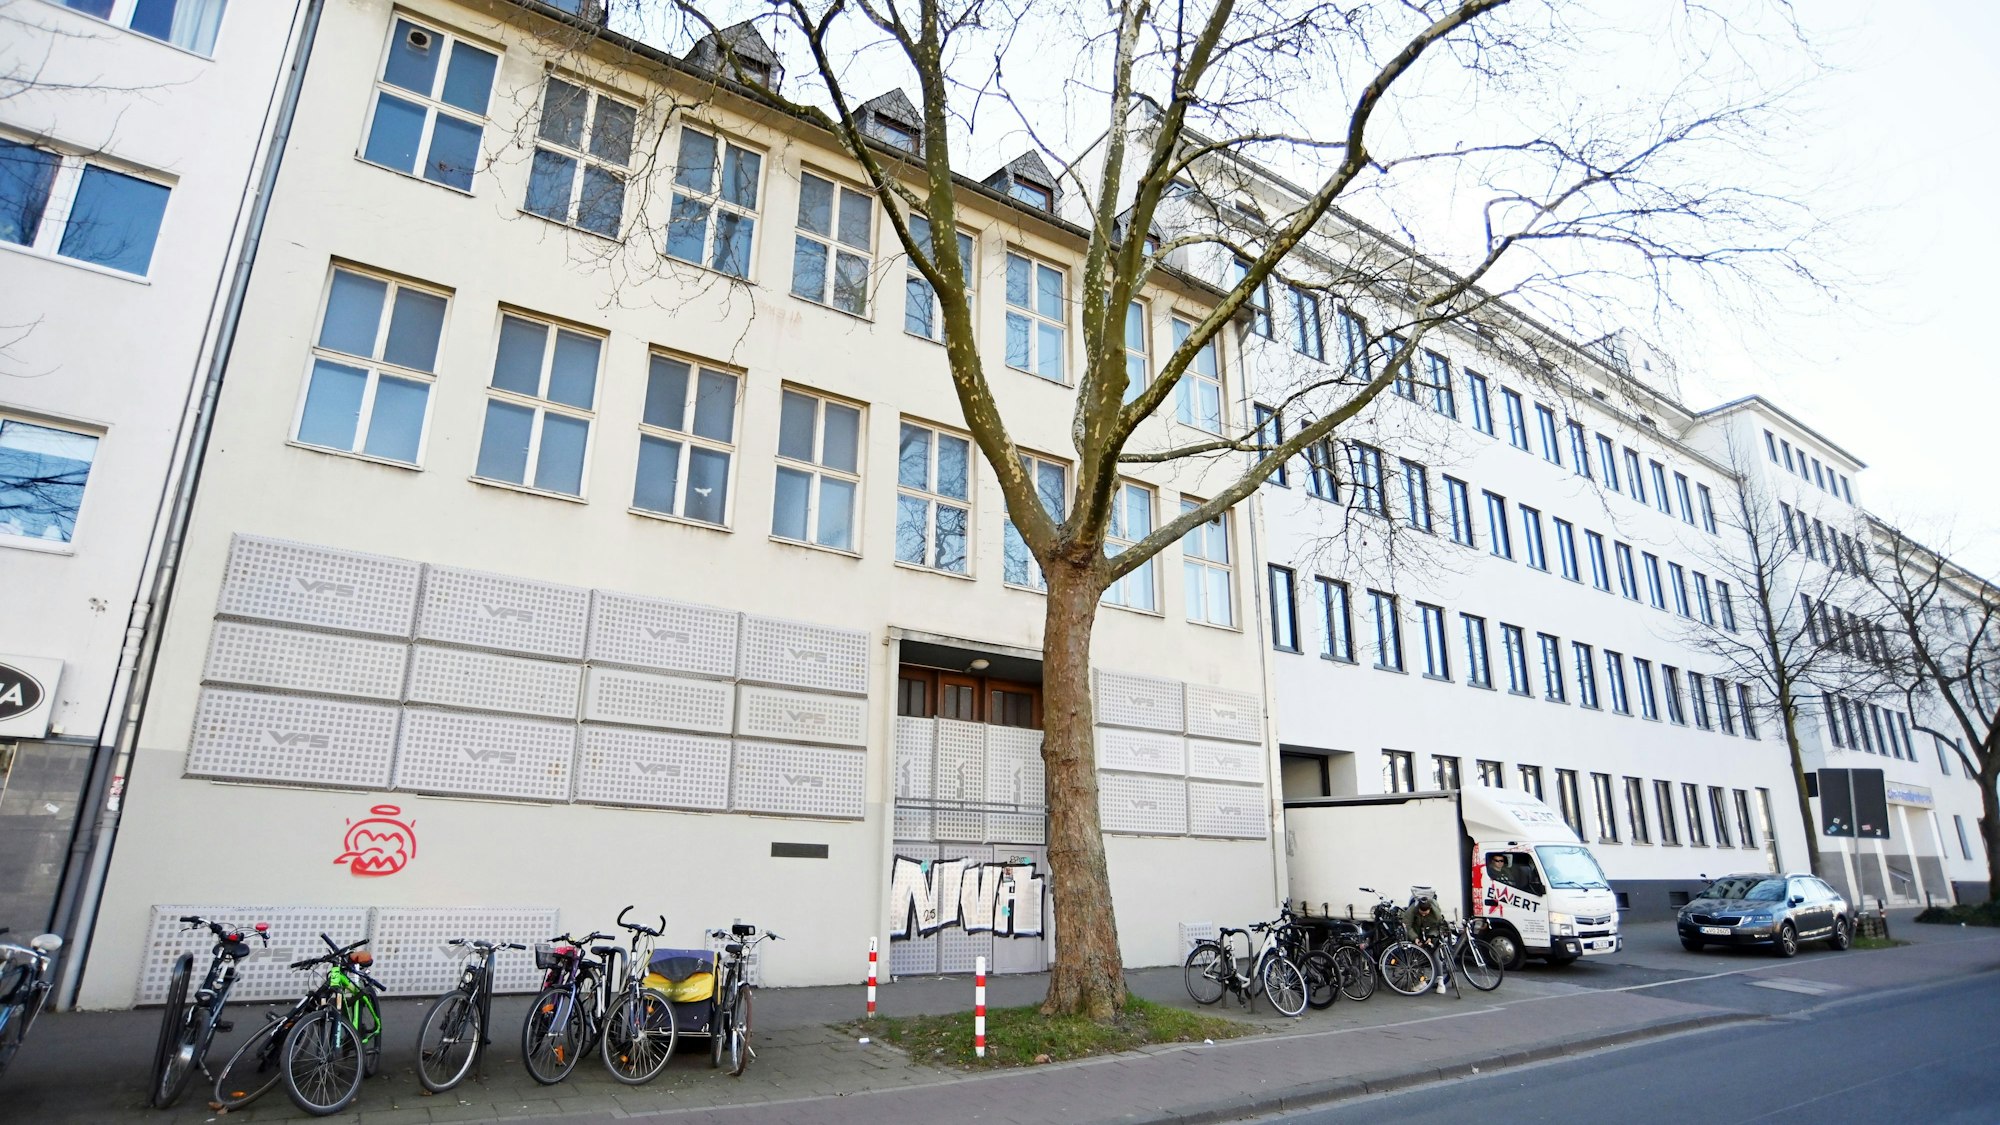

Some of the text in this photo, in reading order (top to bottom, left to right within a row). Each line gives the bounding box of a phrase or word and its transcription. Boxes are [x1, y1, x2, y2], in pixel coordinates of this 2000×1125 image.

[296, 577, 355, 597] VPS
[483, 604, 534, 623] VPS
[645, 628, 690, 644] VPS
[787, 648, 827, 662] VPS
[0, 683, 23, 706] A
[1128, 696, 1155, 707] VPS
[786, 709, 826, 724] VPS
[1213, 708, 1236, 719] VPS
[268, 730, 329, 748] VPS
[463, 748, 517, 764] VPS
[1129, 746, 1160, 759] VPS
[634, 761, 681, 776] VPS
[1215, 756, 1242, 768] VPS
[783, 774, 823, 787] VPS
[901, 759, 911, 797] VPS
[956, 761, 965, 799] VPS
[1013, 767, 1021, 803] VPS
[1131, 799, 1157, 810] VPS
[1217, 806, 1241, 815] VPS
[1487, 886, 1541, 913] EWERT
